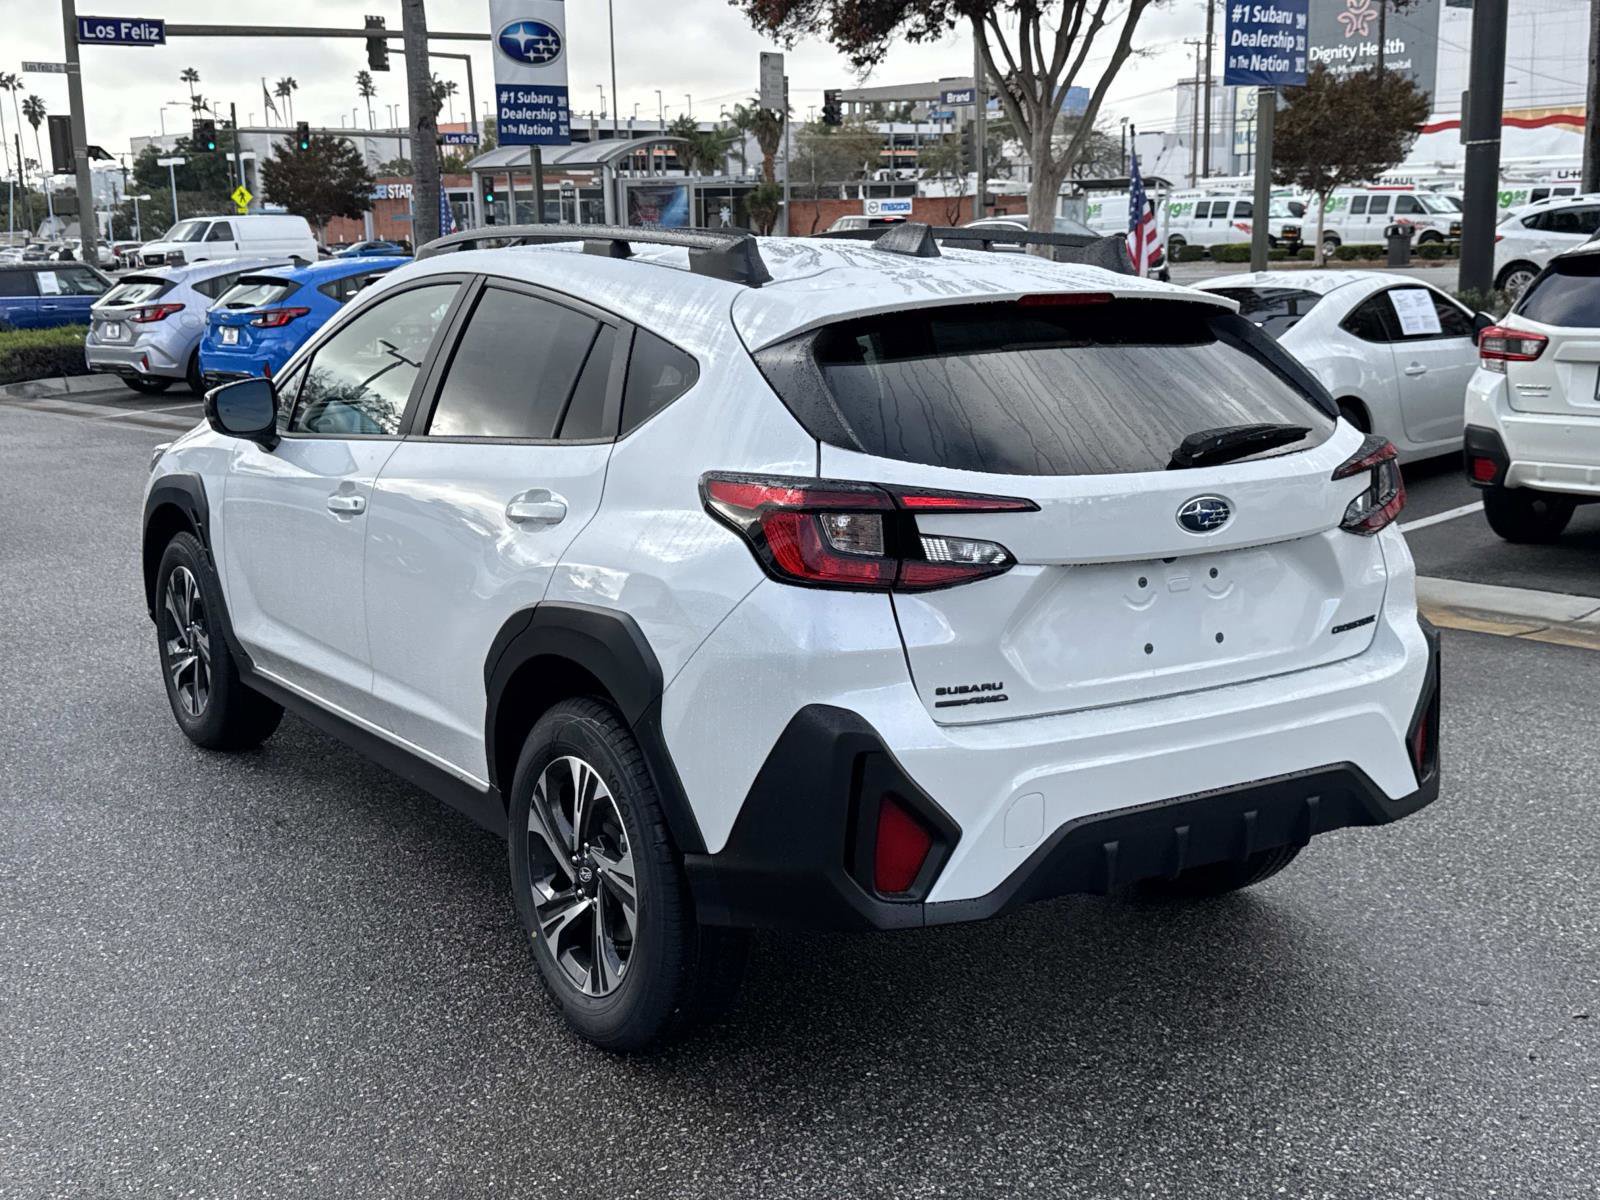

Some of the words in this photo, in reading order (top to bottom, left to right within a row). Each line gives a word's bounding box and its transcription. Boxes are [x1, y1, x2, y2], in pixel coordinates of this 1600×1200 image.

[1231, 4, 1250, 23] #1
[1252, 5, 1293, 24] Subaru
[83, 21, 116, 39] Los
[120, 22, 160, 40] Feliz
[1231, 29, 1295, 53] Dealership
[1308, 44, 1357, 63] Dignity
[1250, 54, 1290, 72] Nation
[500, 91, 515, 104] #1
[517, 91, 554, 105] Subaru
[946, 92, 970, 104] Brand
[501, 107, 557, 122] Dealership
[518, 124, 553, 135] Nation
[445, 134, 459, 144] Los
[460, 134, 478, 144] Feliz
[881, 203, 911, 211] mazda
[935, 682, 1003, 695] SUBARU
